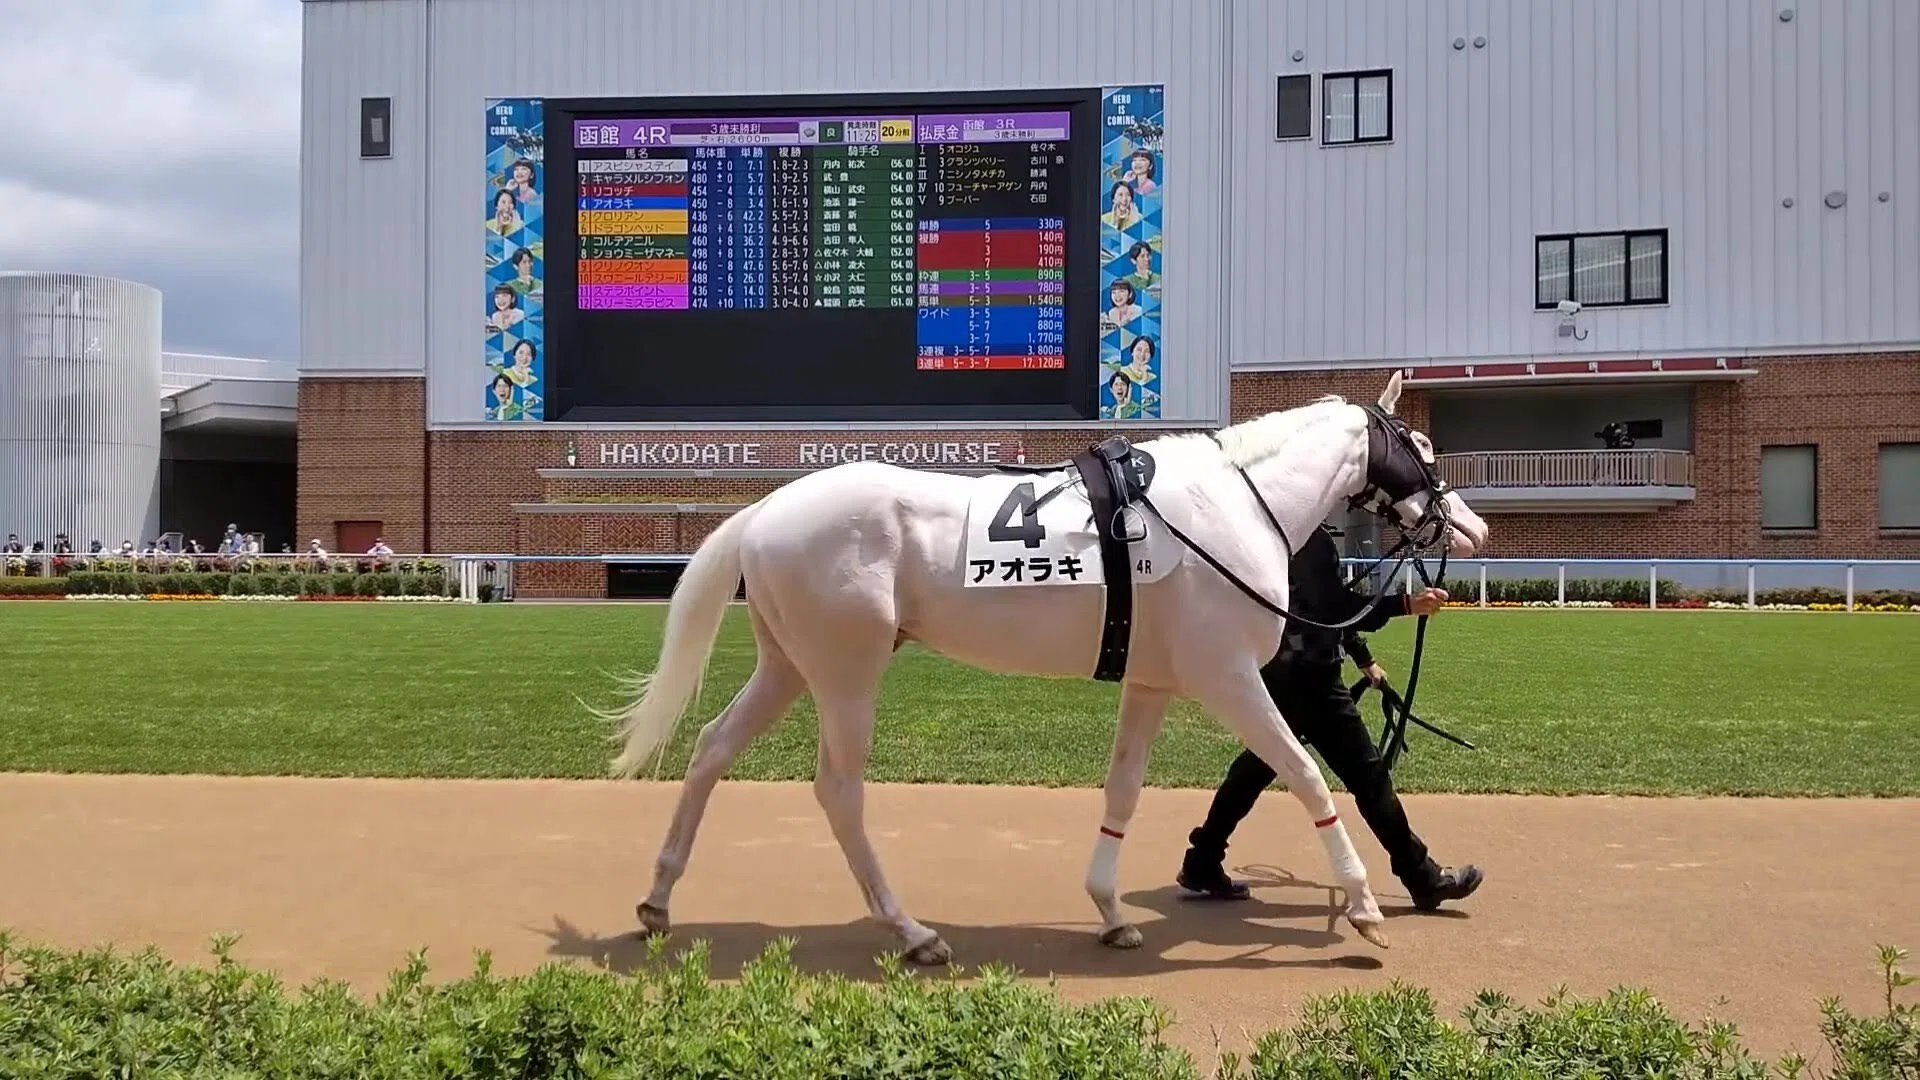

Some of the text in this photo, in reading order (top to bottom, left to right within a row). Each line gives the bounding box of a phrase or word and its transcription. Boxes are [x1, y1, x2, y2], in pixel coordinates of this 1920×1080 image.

[1113, 94, 1131, 104] HERO
[1118, 106, 1125, 114] IS
[501, 117, 507, 125] IS
[1107, 116, 1135, 125] COMING
[920, 125, 959, 140] 払戻金
[996, 119, 1015, 129] 3R
[579, 126, 666, 145] 函館 4R
[847, 130, 877, 141] 11:25
[939, 145, 945, 154] 5
[581, 161, 587, 172] 1
[691, 160, 707, 171] 454
[748, 160, 763, 171] 7.1
[772, 160, 808, 170] 1.8-2.3
[939, 158, 945, 167] 3
[581, 174, 587, 184] 2
[593, 173, 685, 184] キャラメルシフォン
[691, 173, 707, 184] 480
[748, 173, 763, 183] 5.7
[772, 172, 808, 183] 1.9-2.5
[939, 170, 945, 180] 7
[581, 186, 587, 197] 3
[593, 186, 634, 196] リコッチ
[692, 186, 707, 196] 454
[748, 185, 763, 196] 4.6
[772, 185, 808, 195] 1.7-2.1
[935, 183, 945, 193] 10
[581, 199, 587, 209] 4
[593, 198, 634, 209] アオラキ
[692, 198, 707, 208] 450
[748, 198, 763, 208] 3.4
[772, 198, 808, 208] 1.6-1.9
[939, 196, 945, 205] 9
[581, 211, 587, 221] 5
[692, 211, 707, 221] 436
[743, 211, 763, 221] 42.2
[772, 210, 808, 220] 5.5-7.3
[581, 224, 587, 234] 6
[692, 223, 707, 234] 448
[743, 223, 763, 233] 12.5
[772, 223, 808, 233] 4.1-5.4
[985, 220, 991, 230] 5
[1039, 219, 1063, 229] 330円
[581, 236, 587, 246] 7
[692, 236, 707, 246] 460
[743, 236, 763, 246] 36.2
[772, 236, 808, 246] 4.9-6.6
[985, 233, 991, 243] 5
[1039, 232, 1063, 242] 140円
[581, 249, 587, 259] 8
[593, 248, 684, 258] ショウミーザマネー
[692, 249, 707, 258] 498
[743, 249, 763, 258] 12.3
[772, 248, 808, 258] 2.8-3.7
[985, 244, 1063, 255] 3 190円
[692, 261, 707, 271] 446
[743, 261, 763, 271] 47.6
[772, 261, 808, 271] 5.6-7.6
[985, 257, 1063, 268] 7 410円
[692, 274, 707, 284] 488
[743, 274, 763, 283] 26.0
[772, 274, 808, 283] 5.5-7.4
[1038, 270, 1063, 280] 890円
[580, 286, 589, 296] 11
[692, 286, 707, 296] 436
[743, 287, 763, 296] 14.0
[772, 287, 808, 296] 3.1-4.0
[1038, 282, 1063, 293] 780円
[580, 299, 589, 308] 12
[692, 299, 707, 308] 474
[718, 299, 733, 308] +10
[743, 299, 763, 308] 11.3
[772, 299, 808, 308] 3.0-4.0
[1038, 308, 1063, 318] 360円
[1038, 320, 1063, 330] 880円
[600, 442, 1001, 464] HAKODATE RACECOURSE
[988, 482, 1046, 549] 4
[970, 556, 1083, 583] アオラキ
[1137, 560, 1152, 574] 4R
